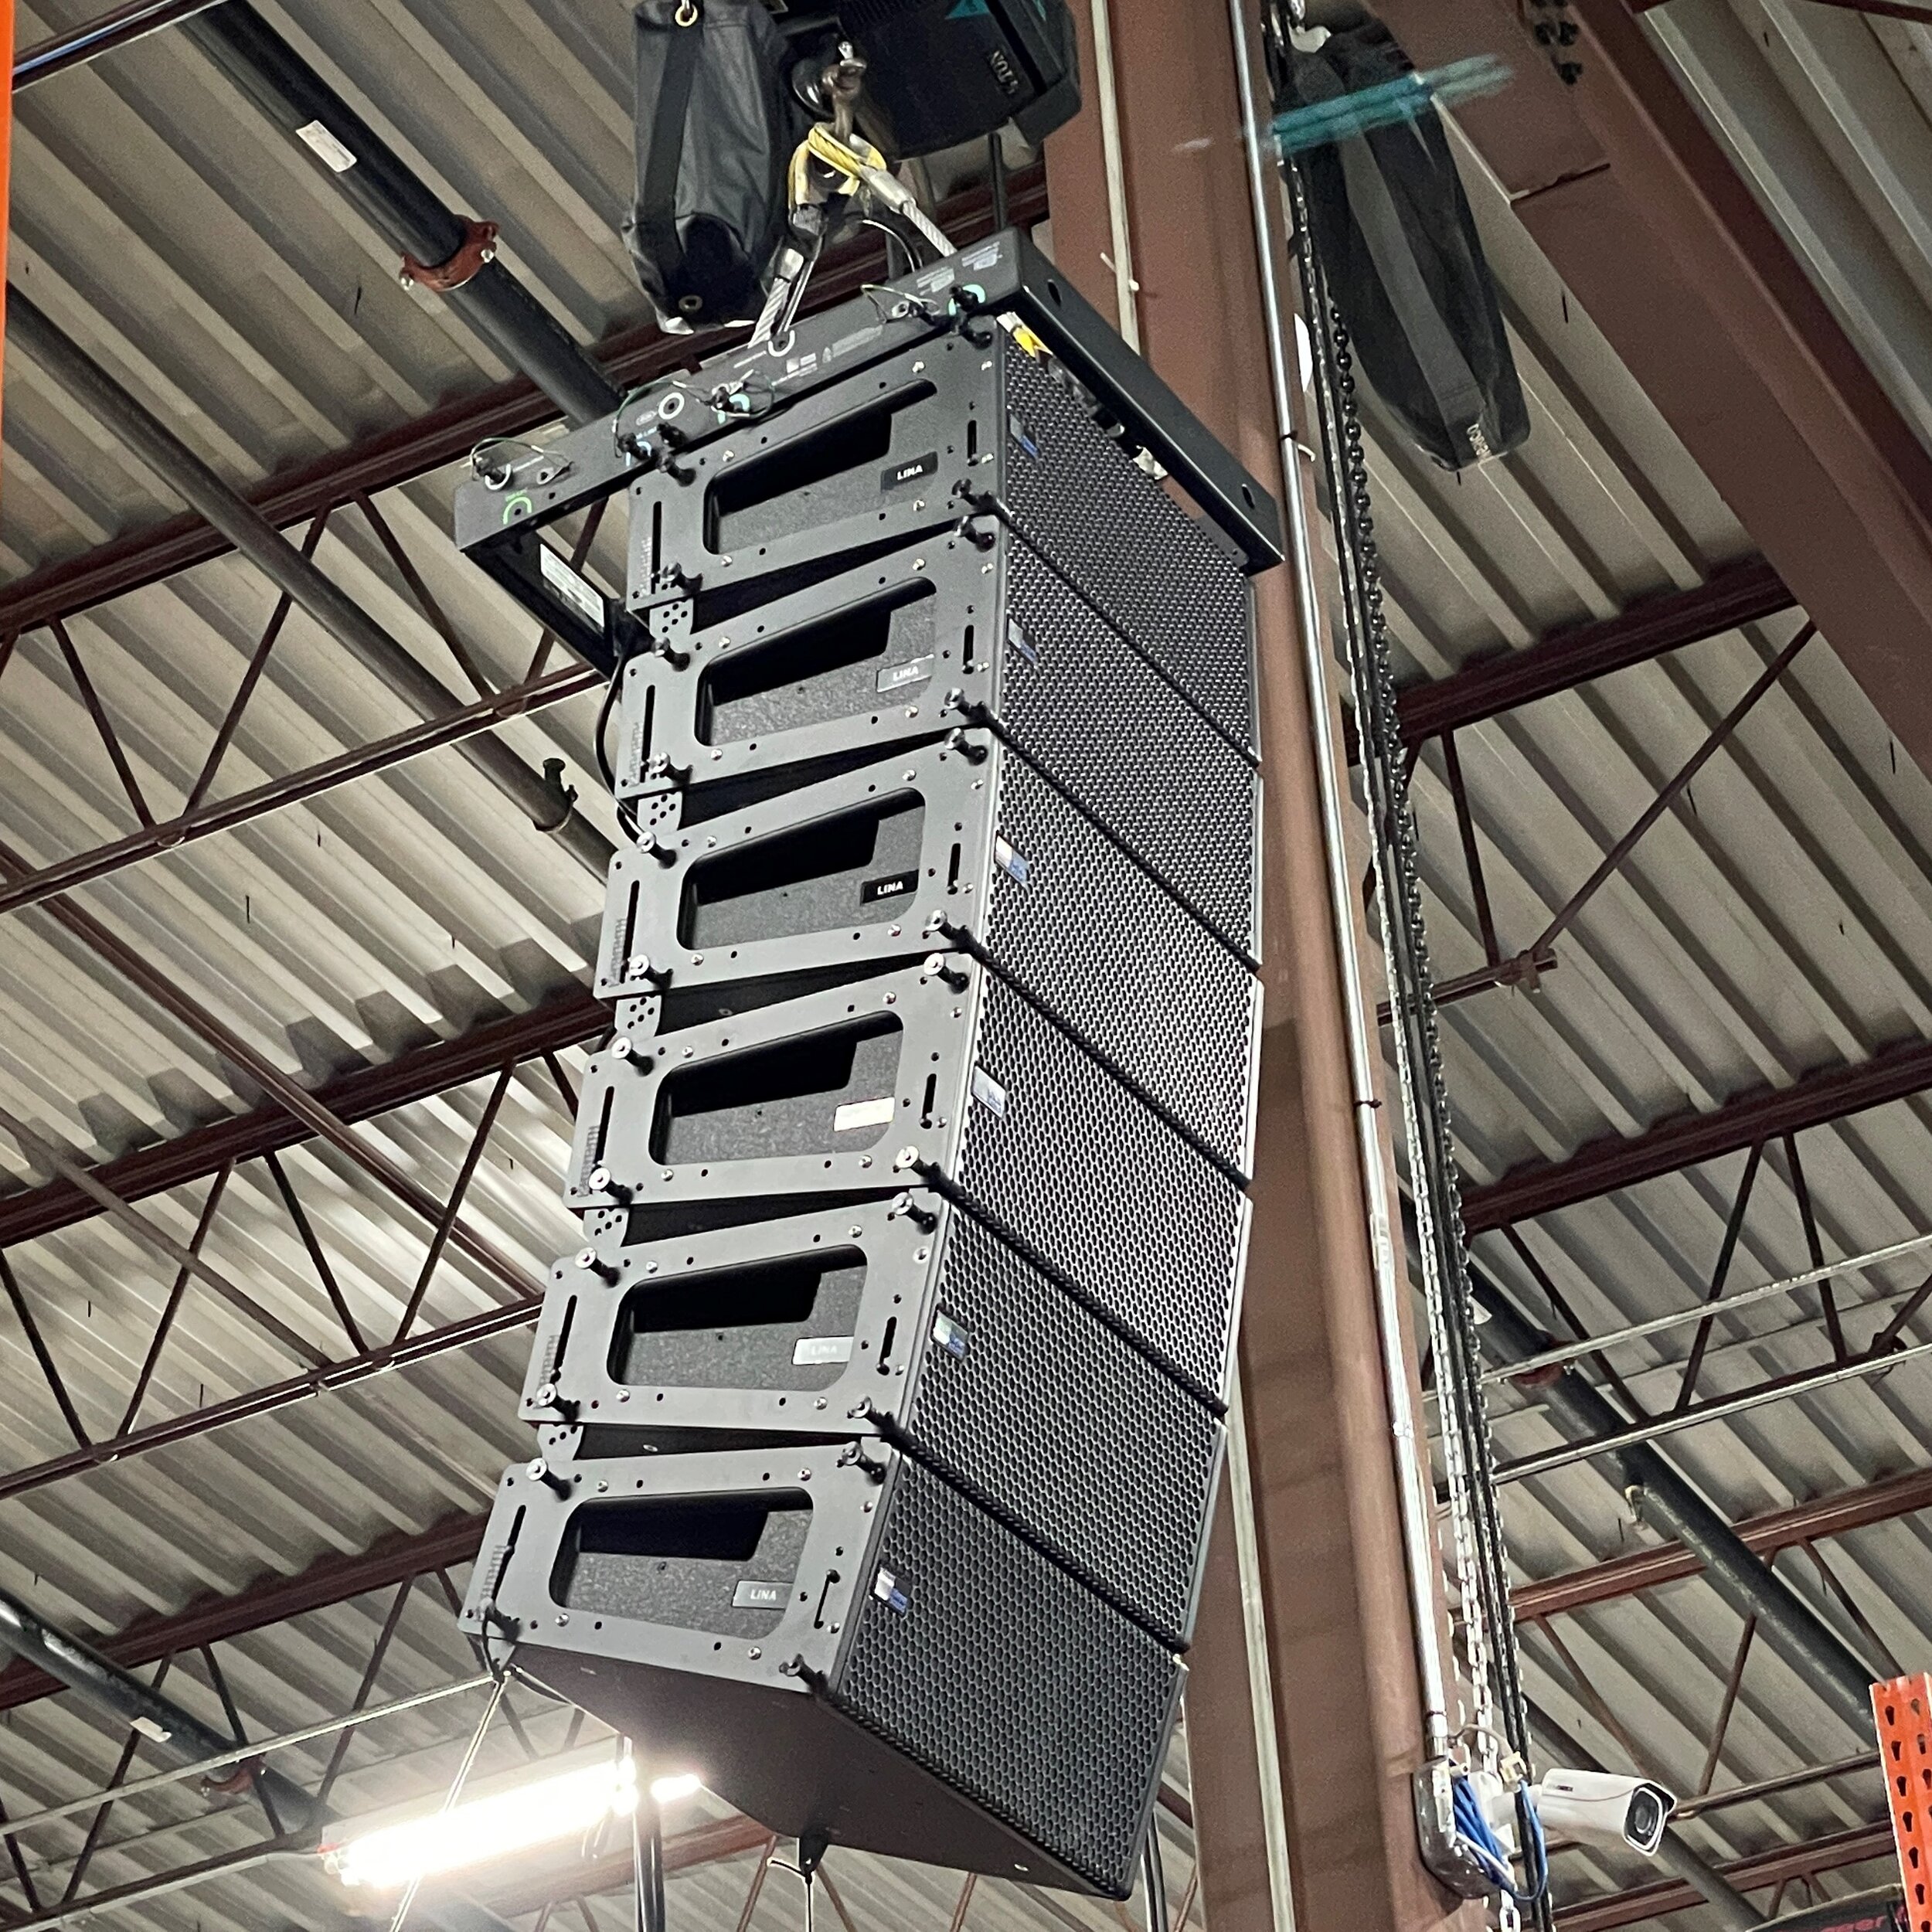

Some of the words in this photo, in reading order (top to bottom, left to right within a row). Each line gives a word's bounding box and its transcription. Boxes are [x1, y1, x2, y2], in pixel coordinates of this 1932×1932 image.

[897, 465, 923, 480] LINA
[893, 666, 919, 681] LINA
[877, 881, 903, 895] LINA
[750, 1589, 777, 1601] LINA
